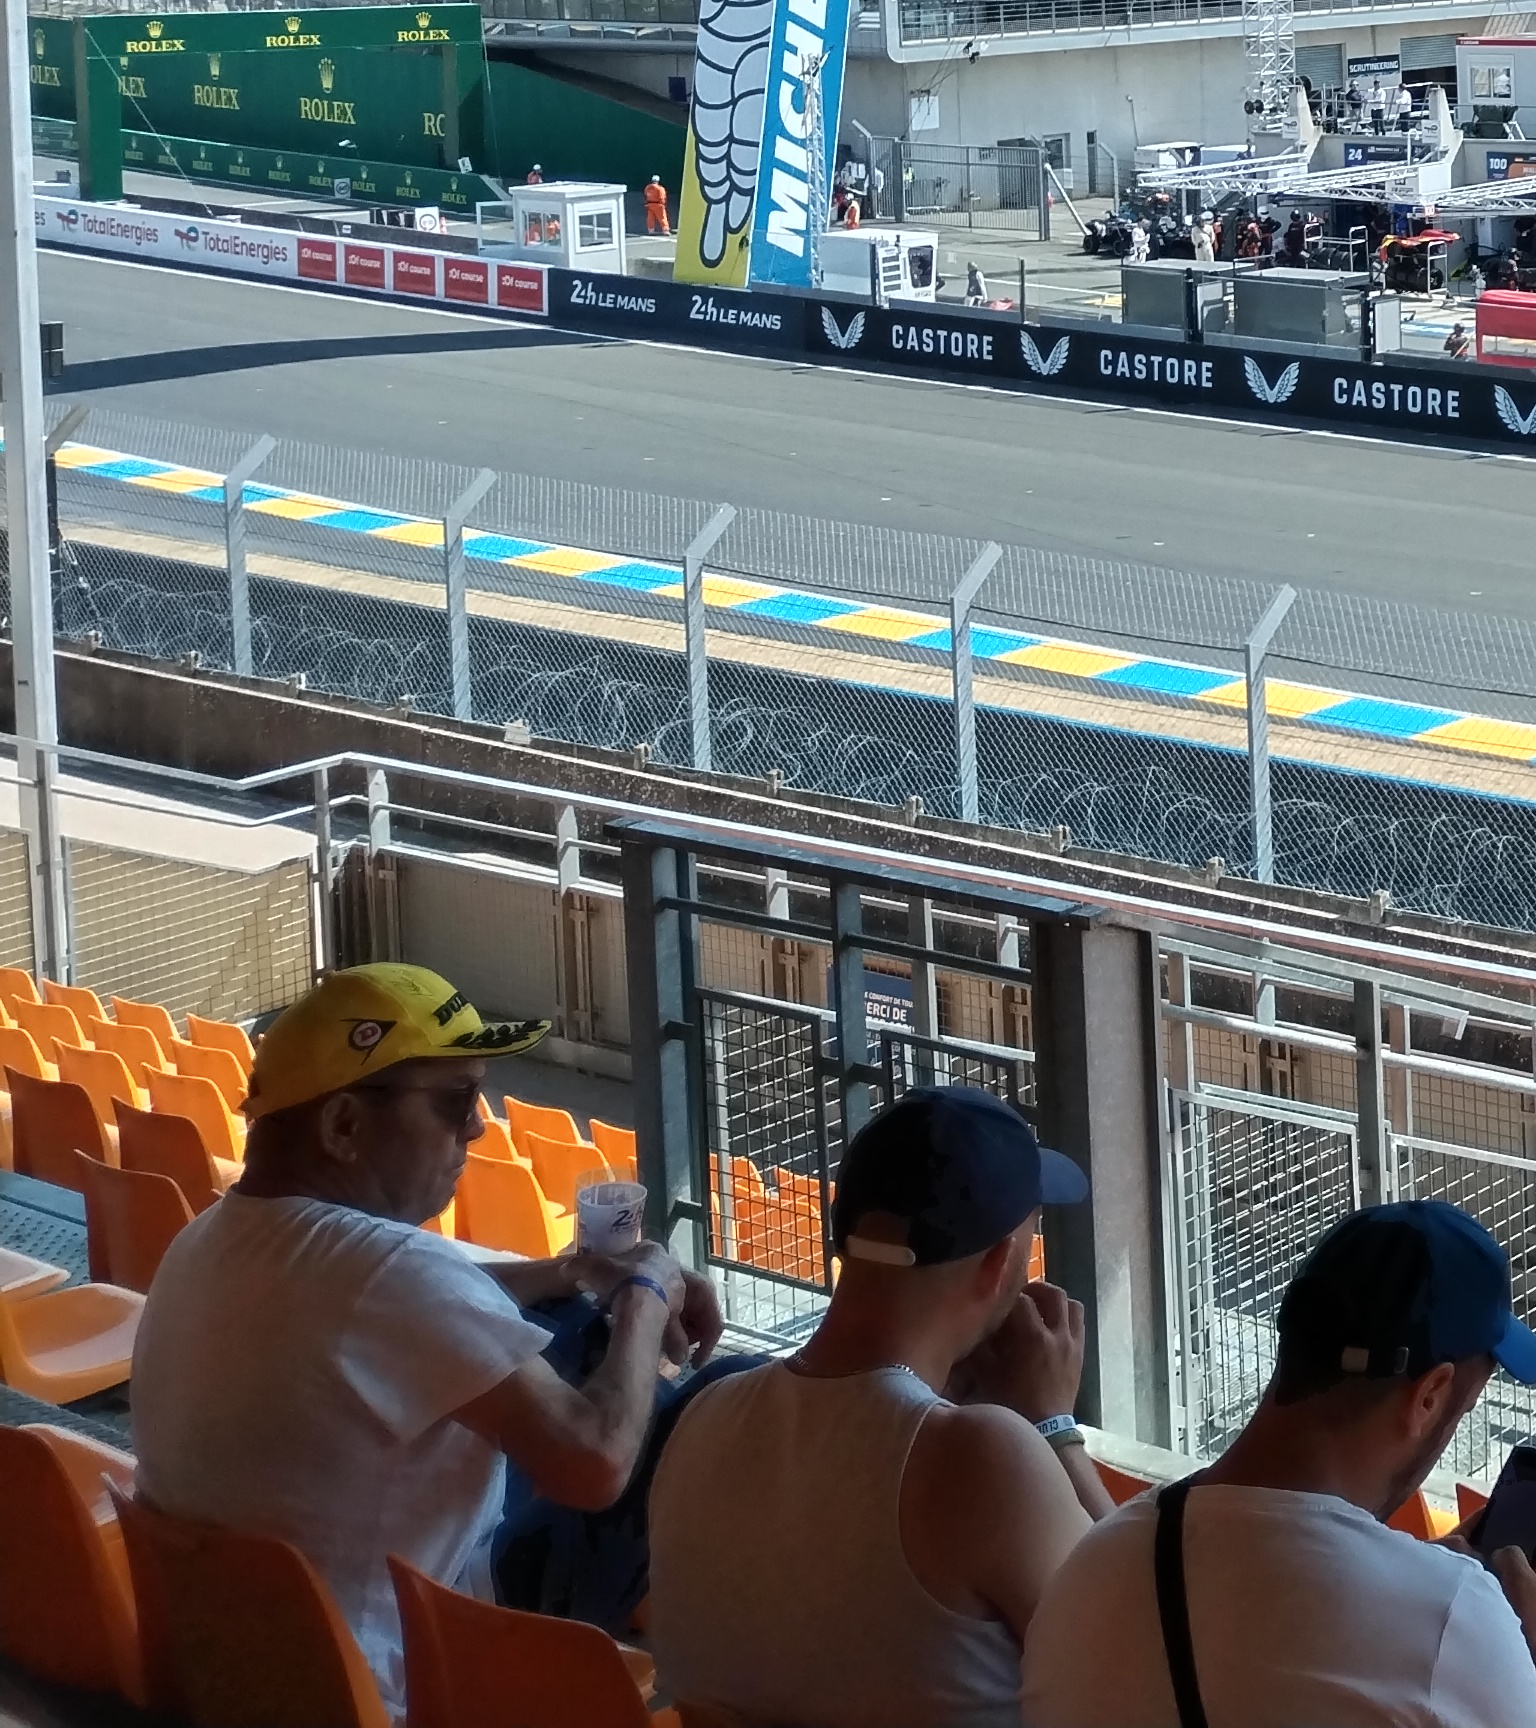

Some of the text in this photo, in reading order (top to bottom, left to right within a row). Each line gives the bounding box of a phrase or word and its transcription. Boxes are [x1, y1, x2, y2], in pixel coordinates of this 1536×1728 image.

[126, 39, 186, 53] ROLEX
[266, 34, 321, 47] ROLEX
[397, 30, 451, 42] ROLEX
[31, 65, 61, 87] OLEX
[1349, 60, 1399, 73] SCRUTINEERING
[194, 84, 240, 110] ROLEX
[300, 97, 356, 125] ROLEX
[1348, 148, 1363, 161] 24
[1489, 158, 1508, 170] 100
[396, 187, 420, 199] ROLEX
[442, 192, 467, 205] ROLEX
[81, 213, 158, 246] TotalEnergies
[202, 231, 287, 265] TotalEnergies
[571, 280, 656, 313] 24h LE MANS
[689, 295, 782, 330] 24h LE MANS
[891, 324, 994, 361] CASTORE
[1100, 349, 1213, 389] CASTORE
[1333, 376, 1461, 419] CASTORE
[865, 1000, 908, 1022] ERCI DE
